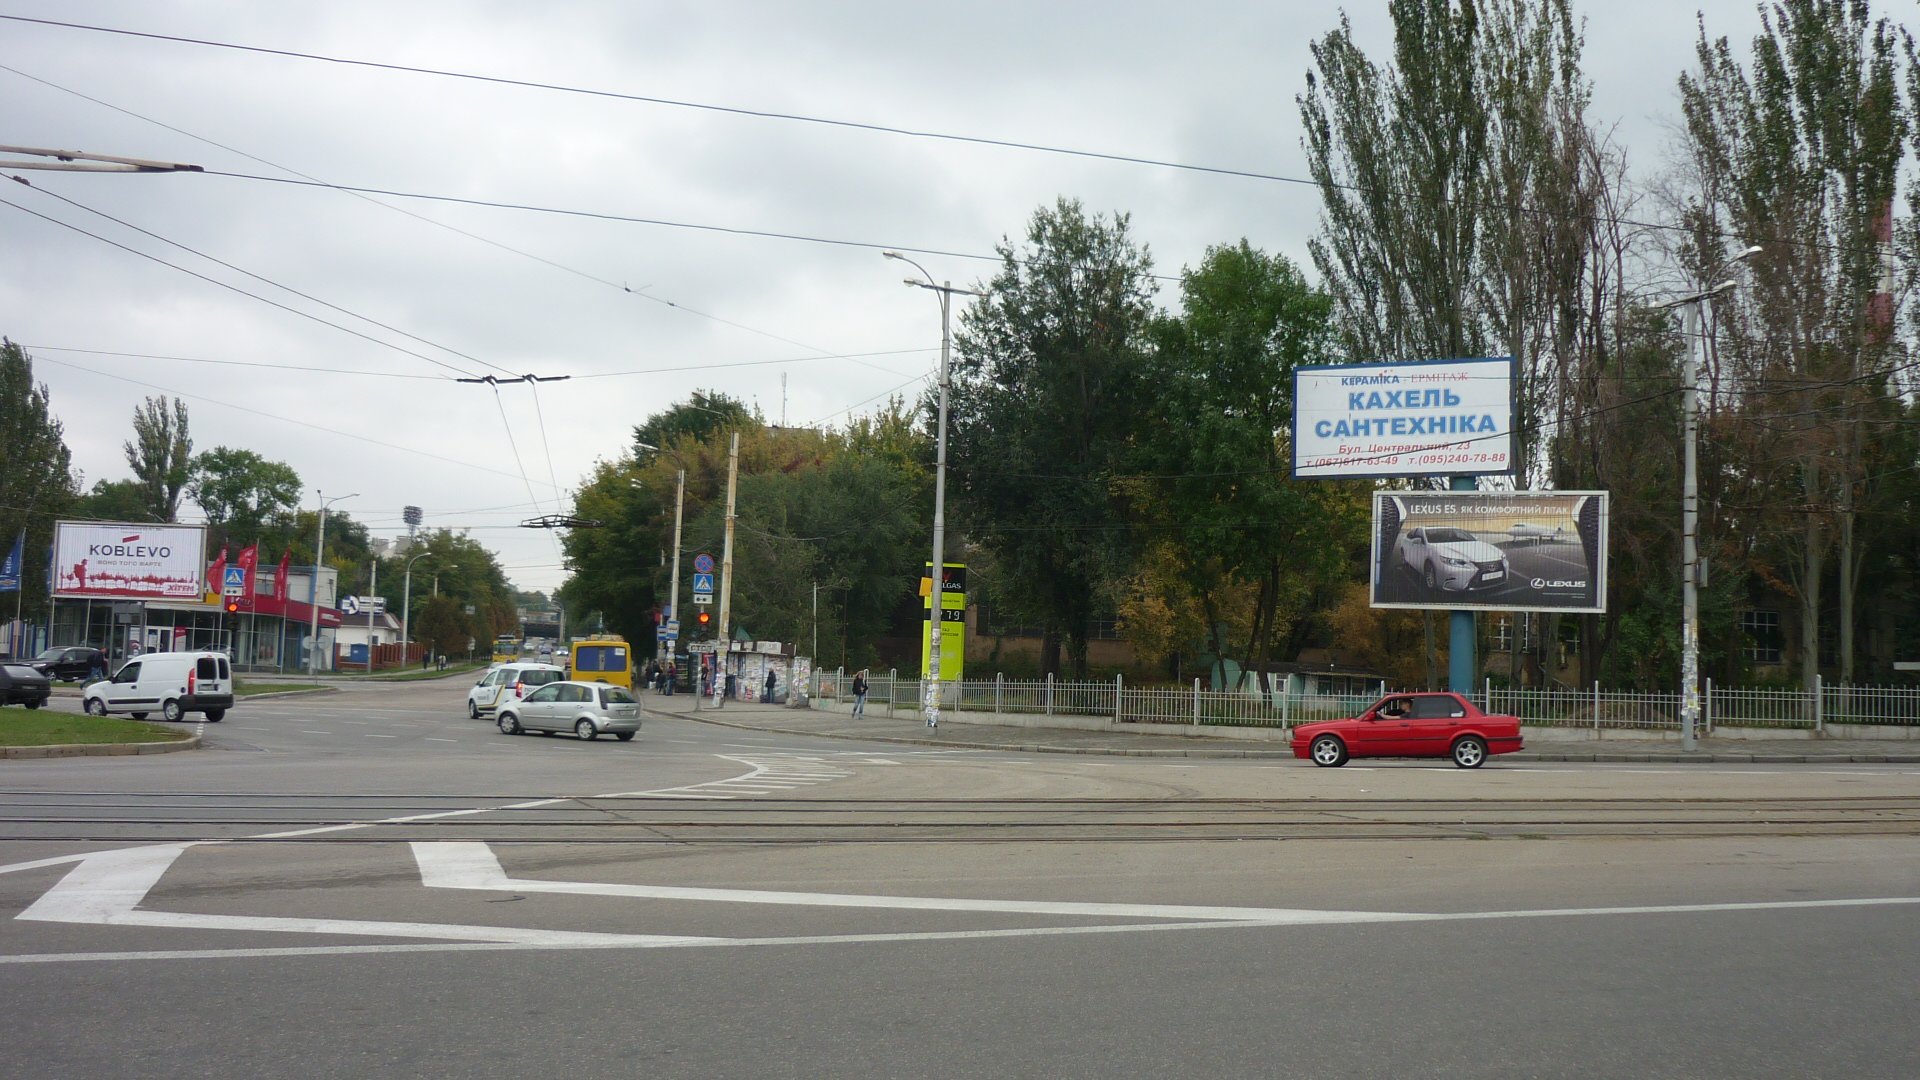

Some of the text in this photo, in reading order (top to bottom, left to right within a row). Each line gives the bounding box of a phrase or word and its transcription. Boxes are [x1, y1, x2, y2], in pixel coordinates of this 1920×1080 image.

[1341, 375, 1400, 386] КЕРАМІКА
[1348, 388, 1461, 410] КАХЕЛЬ
[1315, 415, 1497, 438] САНТЕХНІКА
[1410, 504, 1442, 515] LEXUS
[1461, 505, 1473, 514] ЯК
[1475, 504, 1542, 515] КОМФОРТНИЙ
[89, 544, 171, 558] KOBLEVO
[941, 582, 962, 590] LGAS
[1546, 580, 1586, 588] LEXUS
